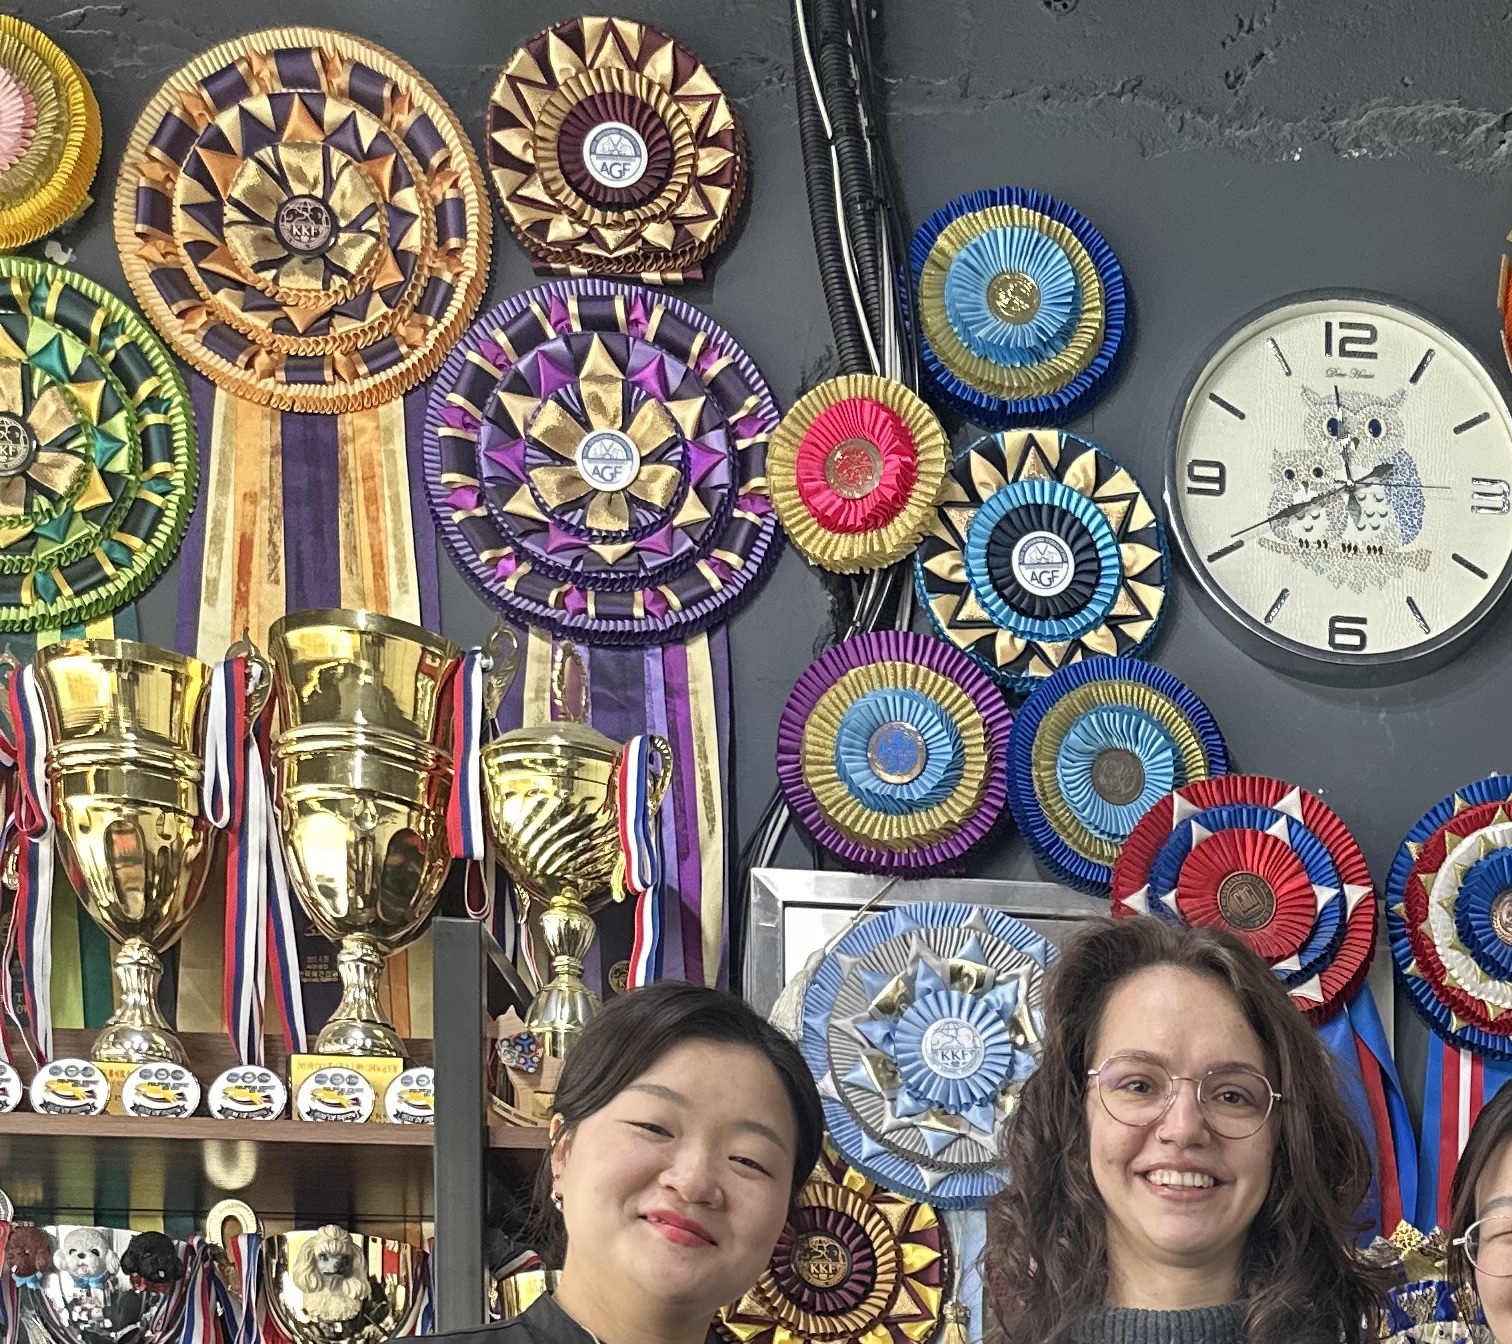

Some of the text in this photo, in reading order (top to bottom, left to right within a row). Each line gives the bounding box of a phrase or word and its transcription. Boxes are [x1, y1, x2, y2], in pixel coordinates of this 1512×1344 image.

[600, 162, 632, 179] AGF
[292, 224, 319, 236] KKF
[1324, 321, 1378, 360] 12
[0, 445, 18, 456] KF
[592, 465, 623, 482] AGF
[1187, 459, 1226, 496] 9
[1471, 477, 1511, 515] 3
[1030, 570, 1060, 587] AGF
[1328, 615, 1368, 651] 6
[940, 1050, 969, 1062] KKF
[810, 1263, 836, 1274] KKF
